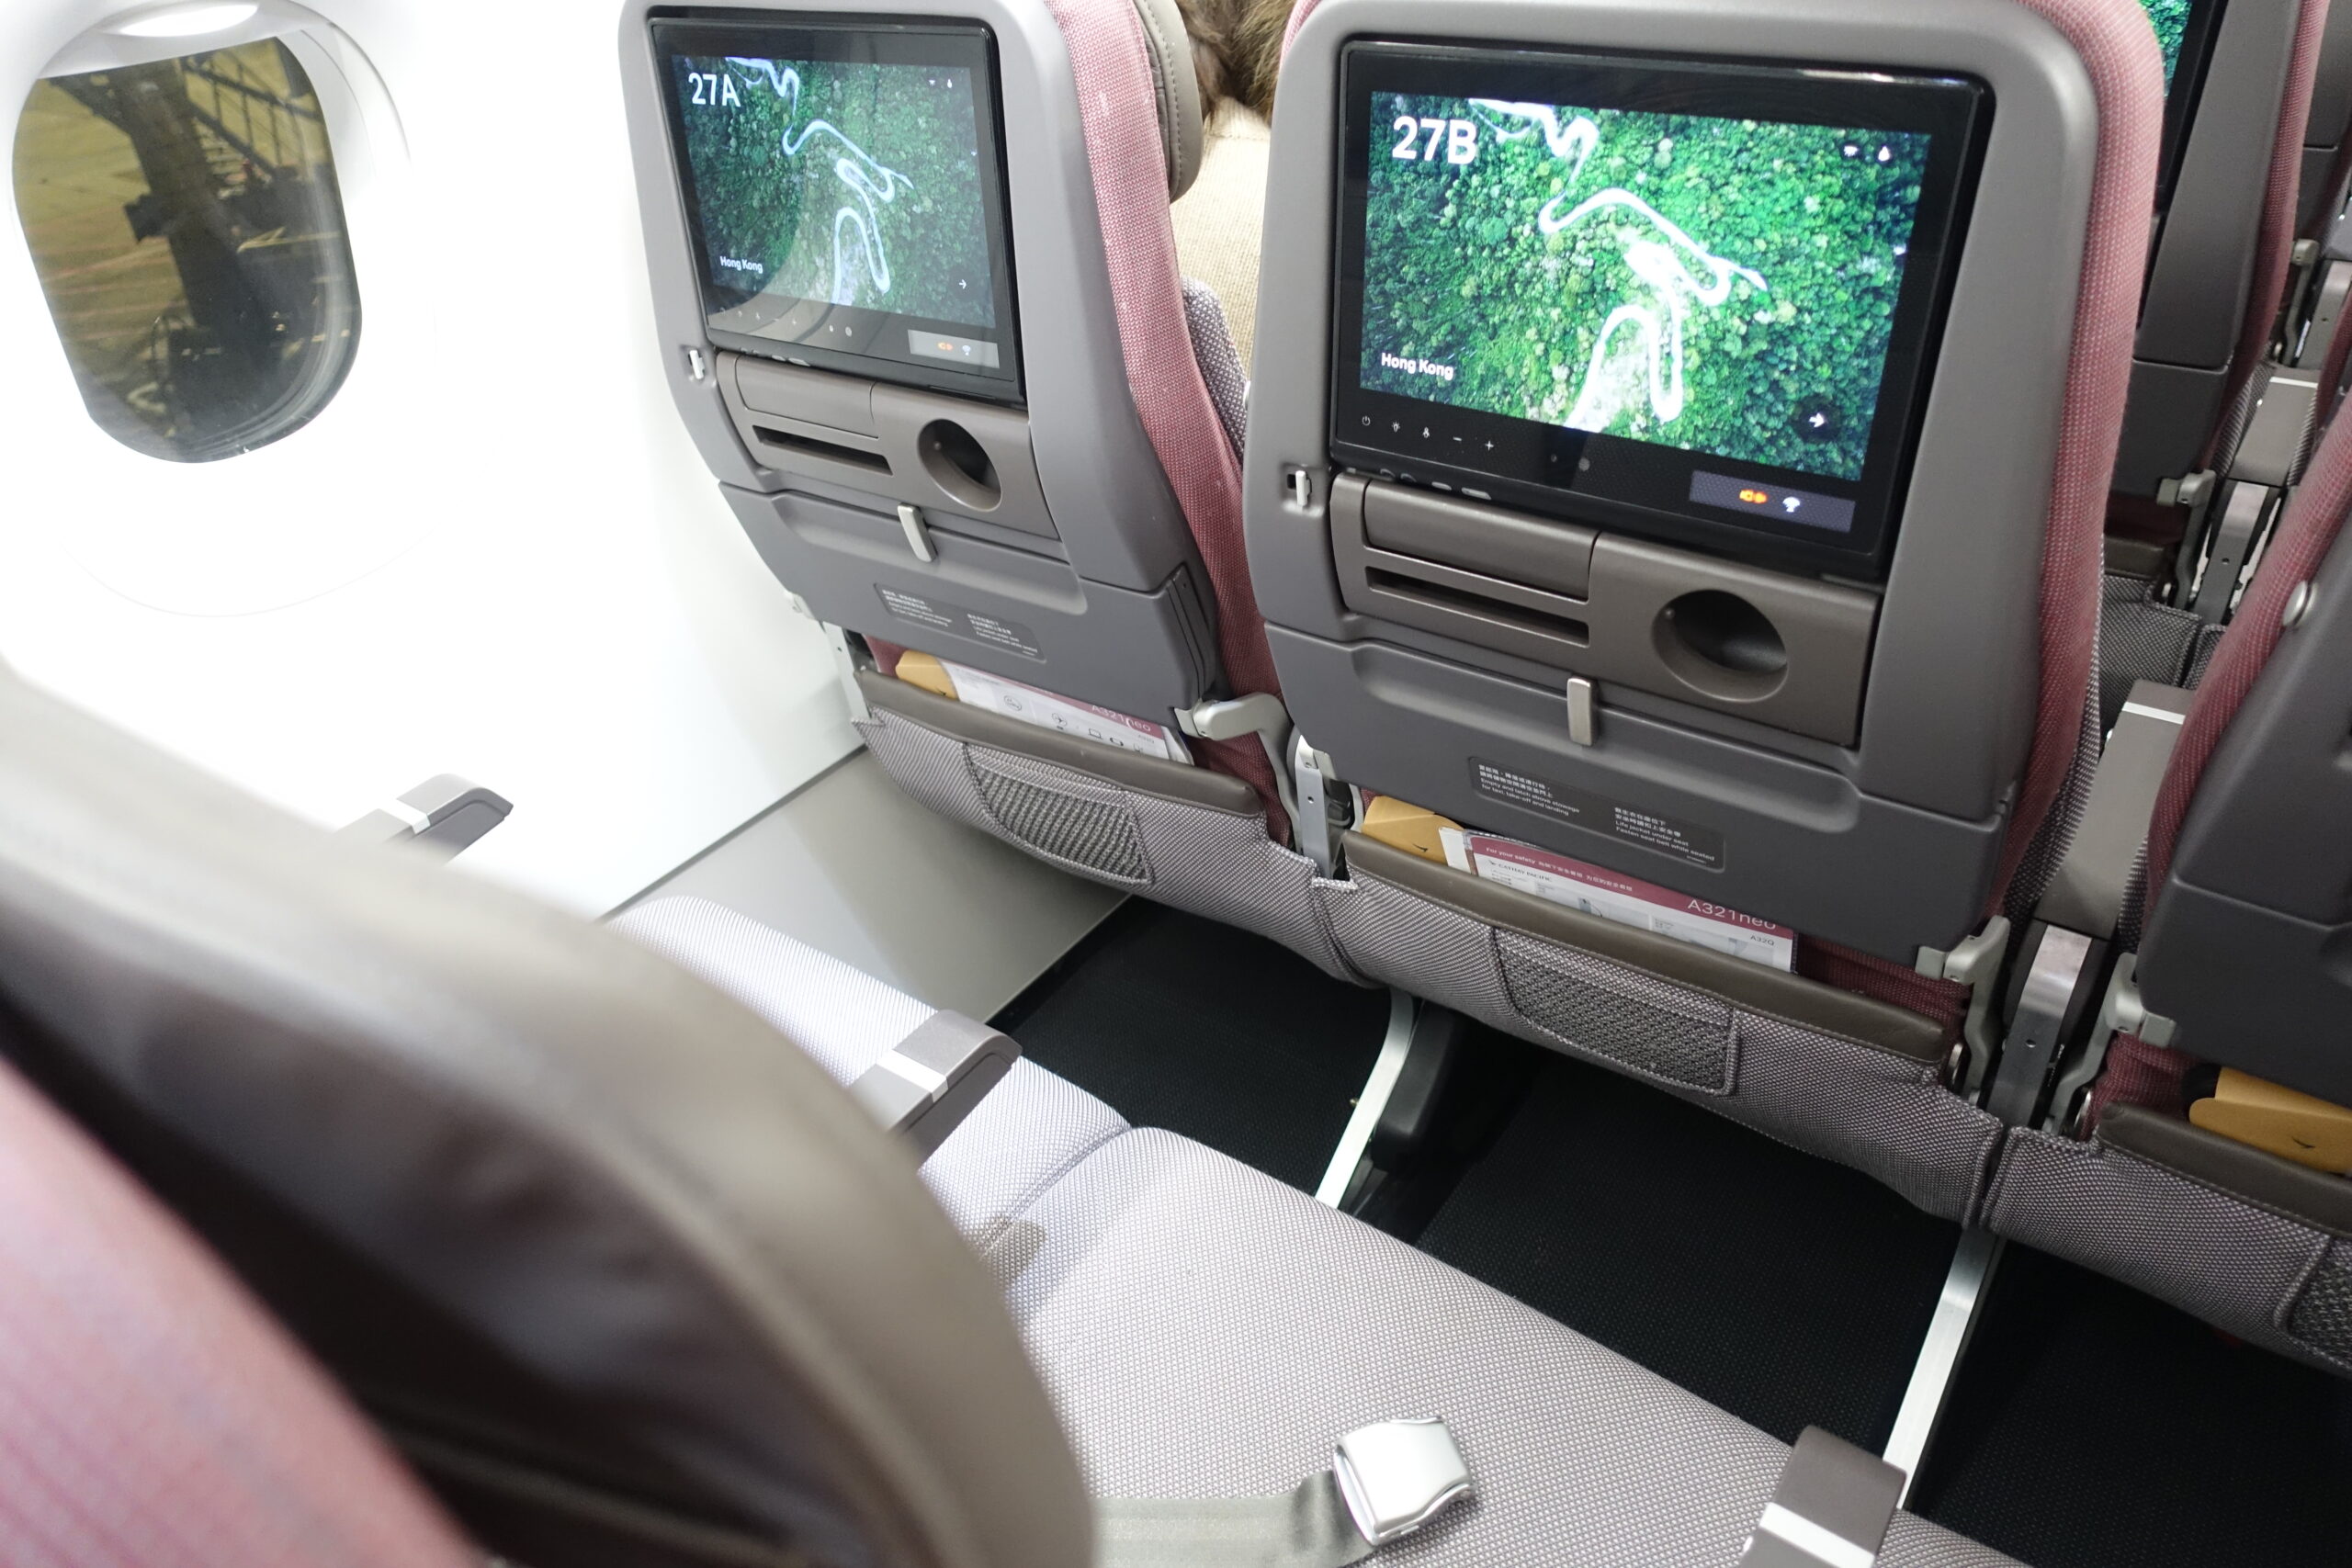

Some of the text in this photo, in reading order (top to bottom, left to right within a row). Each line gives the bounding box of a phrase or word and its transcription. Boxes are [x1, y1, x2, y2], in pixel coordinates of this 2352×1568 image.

[688, 72, 741, 107] 27A
[1390, 115, 1478, 165] 27B
[719, 256, 763, 274] Hong Kong
[1380, 352, 1455, 382] Hong Kong
[1480, 777, 1580, 814] Empty and latch above stowage
[1482, 784, 1491, 792] for
[1506, 790, 1532, 804] take-off
[1532, 799, 1544, 808] and
[1544, 803, 1569, 816] landing
[1615, 820, 1689, 847] Life jacket under seat
[1615, 826, 1640, 838] Fasten
[1640, 833, 1655, 843] seat
[1657, 837, 1669, 847] belt
[1671, 843, 1689, 853] while
[1690, 849, 1715, 862] seated
[1486, 846, 1498, 855] For
[1498, 850, 1513, 860] your
[1514, 853, 1536, 864] safety
[1498, 863, 1526, 876] CATHAY
[1526, 870, 1553, 882] PACIFIC
[1687, 898, 1777, 930] A321neo
[1749, 935, 1775, 946] A32Q
